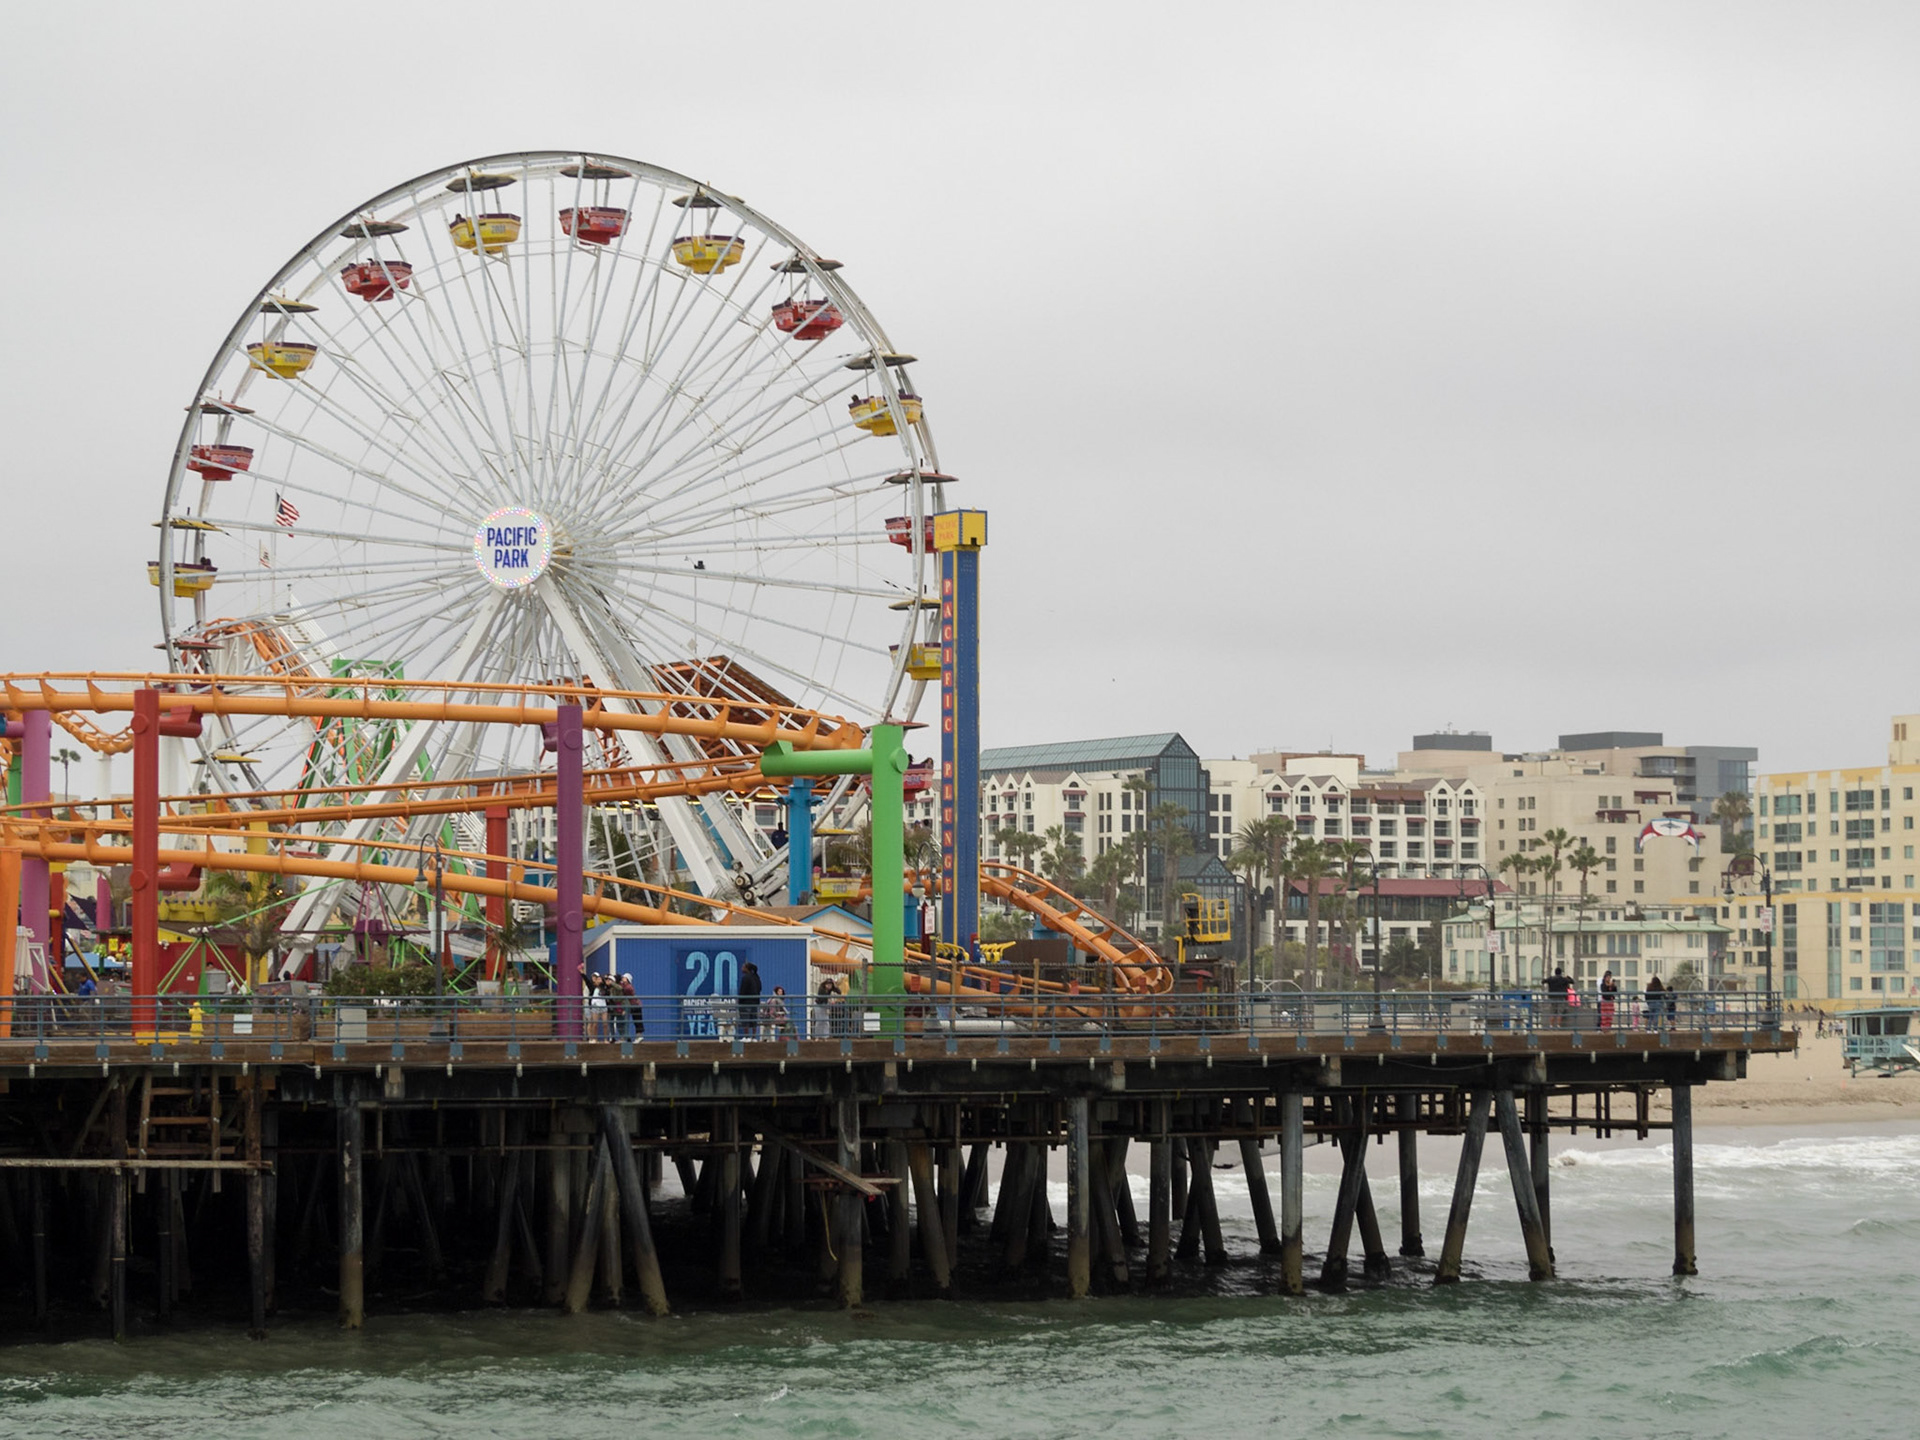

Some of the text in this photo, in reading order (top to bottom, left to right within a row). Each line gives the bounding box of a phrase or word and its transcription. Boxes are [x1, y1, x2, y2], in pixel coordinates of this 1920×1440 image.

[487, 526, 537, 547] PACIFIC
[494, 548, 529, 568] PARK
[944, 580, 952, 730] PACIFIC
[944, 763, 952, 892] PLUNGE
[685, 951, 738, 997] 20
